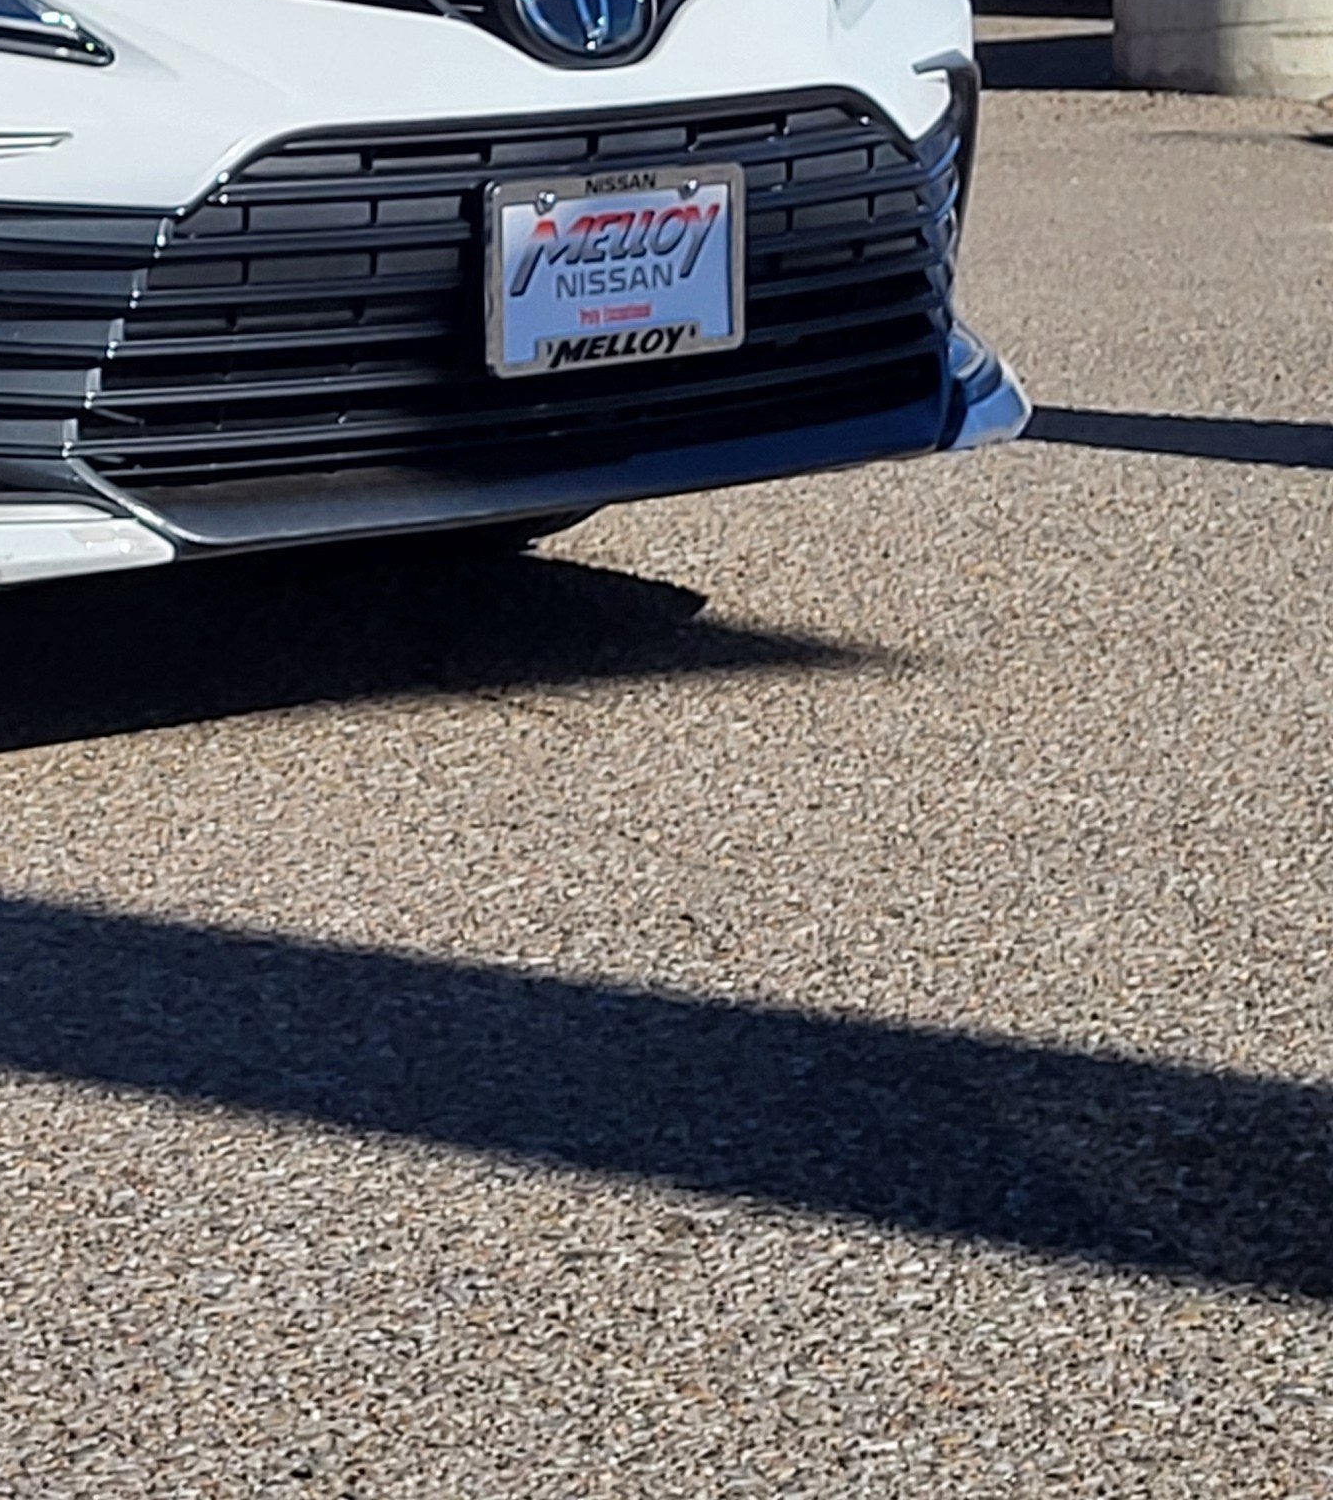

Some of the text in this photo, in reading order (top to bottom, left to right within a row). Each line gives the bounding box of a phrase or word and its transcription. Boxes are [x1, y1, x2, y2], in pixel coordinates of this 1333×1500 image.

[585, 172, 656, 194] NISSAN
[510, 203, 720, 297] MELLOY
[556, 263, 673, 299] NISSAN
[549, 325, 684, 369] MELLOY
